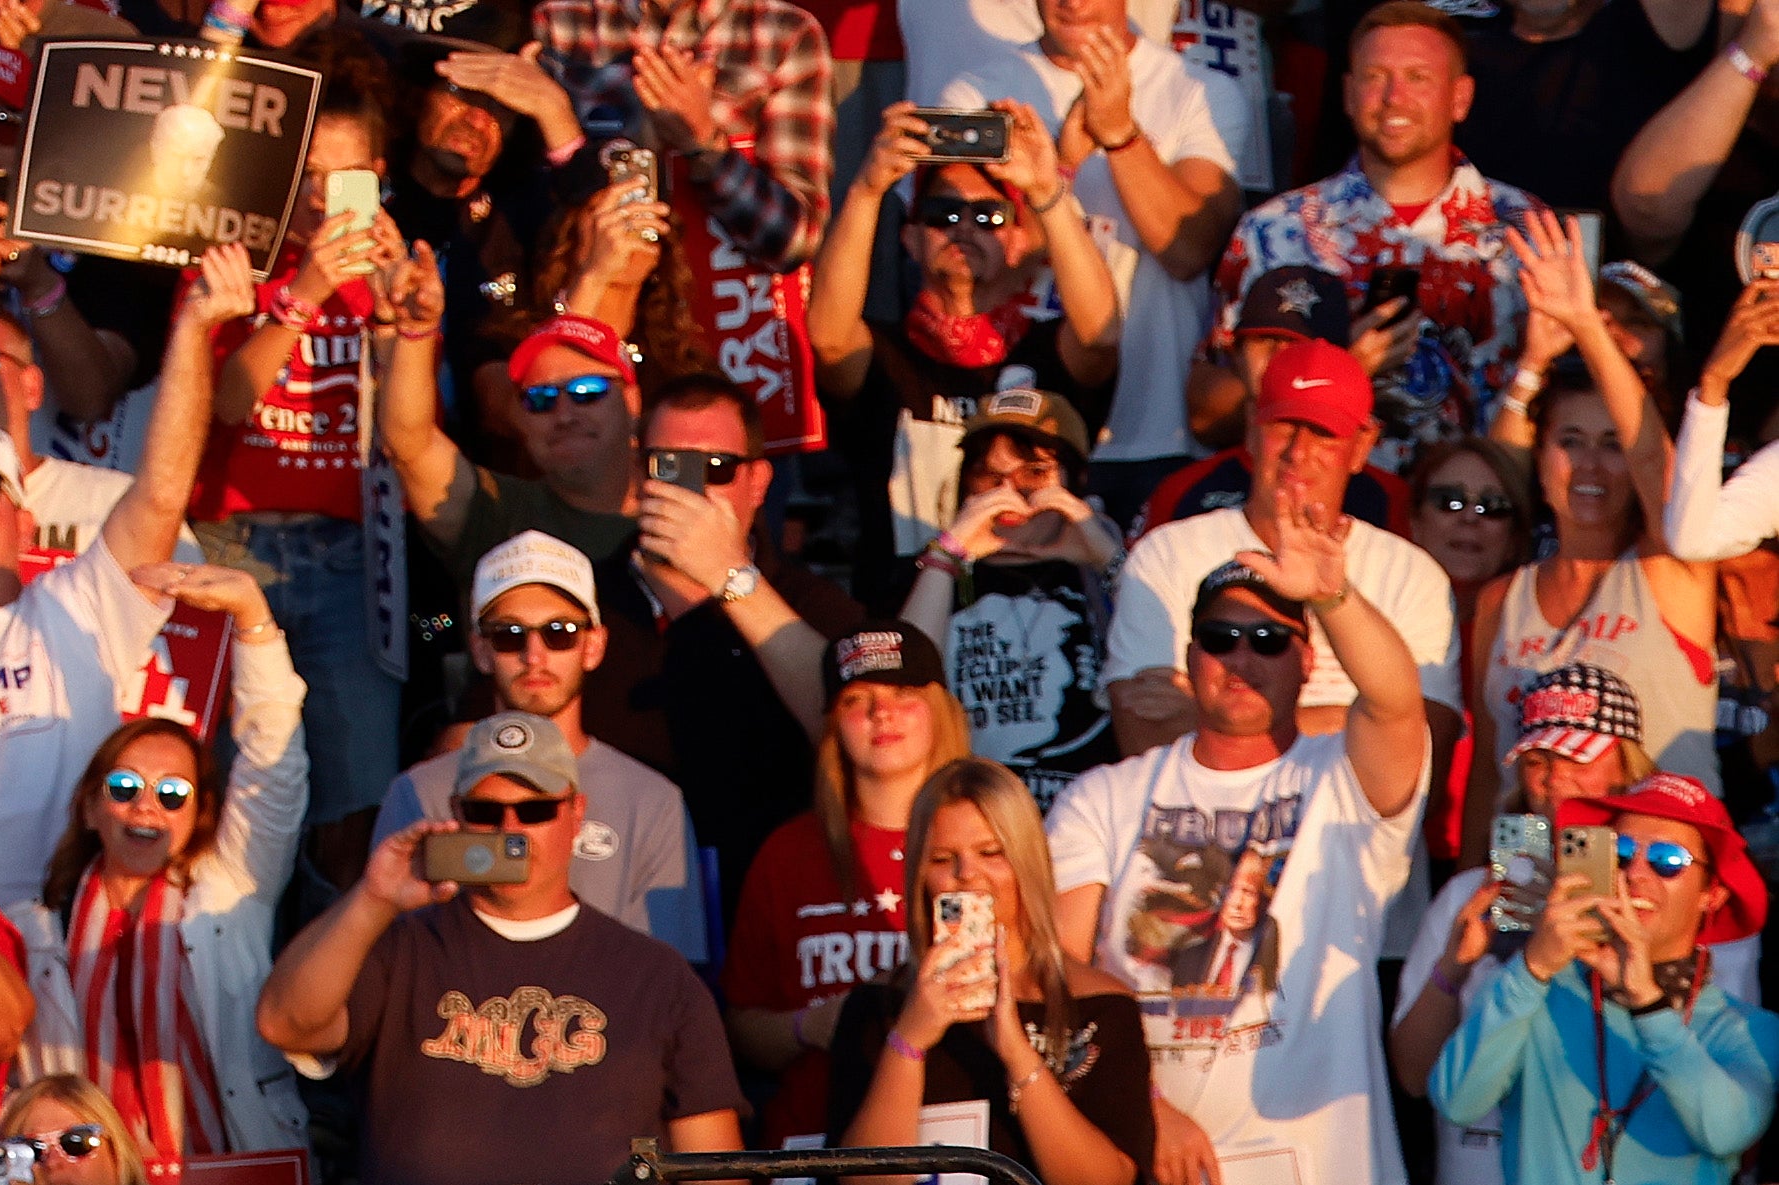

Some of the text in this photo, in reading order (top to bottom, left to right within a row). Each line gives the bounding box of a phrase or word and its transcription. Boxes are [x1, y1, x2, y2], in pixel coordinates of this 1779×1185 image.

[72, 62, 288, 139] NEVER
[33, 179, 279, 254] SURRENDER
[958, 622, 994, 639] THE
[958, 641, 1012, 659] ONLY
[971, 676, 1043, 702] WANT
